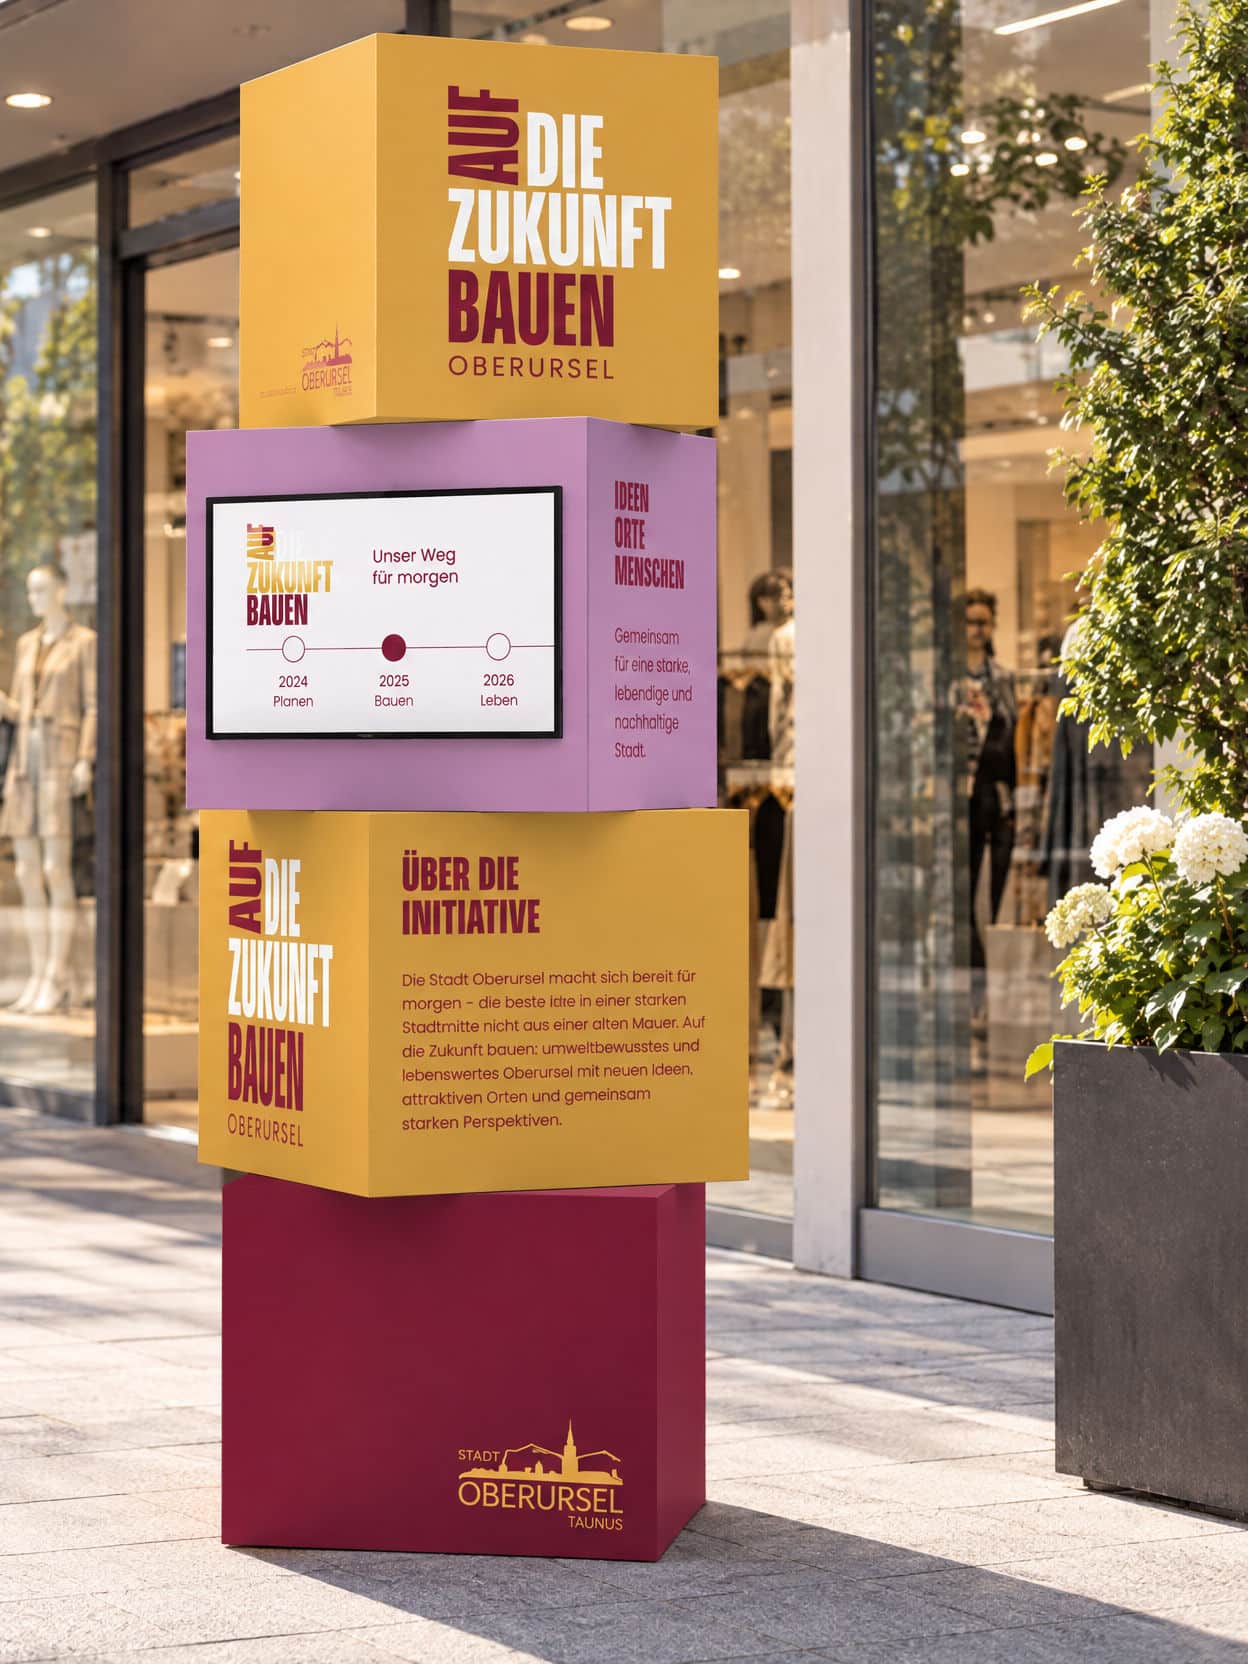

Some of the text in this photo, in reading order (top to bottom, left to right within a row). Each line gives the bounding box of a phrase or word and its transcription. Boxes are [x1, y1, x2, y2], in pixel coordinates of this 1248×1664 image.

[447, 85, 520, 186] AUF
[527, 111, 604, 190] DIE
[447, 187, 673, 270] ZUKUNFT
[448, 268, 614, 348] BAUEN
[448, 355, 614, 380] OBERURSEL
[614, 479, 649, 513] IDEEN
[245, 523, 275, 562] AUF
[614, 516, 646, 550] ORTE
[373, 547, 456, 566] Unser Weg
[246, 559, 334, 593] ZUKUNFT
[372, 569, 459, 588] für morgen
[614, 557, 685, 590] MENSCHEN
[246, 593, 308, 626] BAUEN
[614, 627, 680, 645] Gemeinsam
[614, 655, 691, 676] für eine starke,
[278, 675, 308, 688] 2024
[379, 674, 410, 688] 2025
[483, 673, 515, 687] 2026
[273, 695, 314, 708] Planen
[374, 694, 414, 707] Bauen
[480, 694, 519, 707] Leben
[614, 684, 694, 707] lebendige und
[614, 713, 680, 735] nachhaltige
[402, 849, 520, 892] ÜBER DIE
[228, 839, 263, 935] AUF
[264, 857, 301, 938] DIE
[402, 898, 541, 936] INITIATIVE
[227, 936, 333, 1028] ZUKUNFT
[402, 969, 697, 987] Die Stadt Oberursel macht sich bereit für
[402, 999, 462, 1014] morgen
[478, 995, 502, 1009] die
[505, 995, 546, 1009] beste
[579, 994, 592, 1007] in
[595, 993, 632, 1008] einer
[634, 992, 687, 1007] starken
[402, 1015, 706, 1034] Stadtmitte nicht aus einer alten Mauer. Auf
[401, 1038, 700, 1059] die Zukunft bauen: umweltbewusstes und
[227, 1020, 304, 1111] BAUEN
[402, 1067, 500, 1082] lebenswertes
[502, 1064, 573, 1080] Oberursel
[577, 1064, 601, 1078] mit
[603, 1065, 648, 1078] neuen
[401, 1087, 651, 1106] attraktiven Orten und gemeinsam
[227, 1112, 304, 1148] OBERURSEL
[402, 1113, 563, 1132] starken Perspektiven.
[457, 1448, 501, 1462] STADT
[458, 1480, 624, 1514] OBERURSEL
[567, 1515, 624, 1531] TAUNUS
